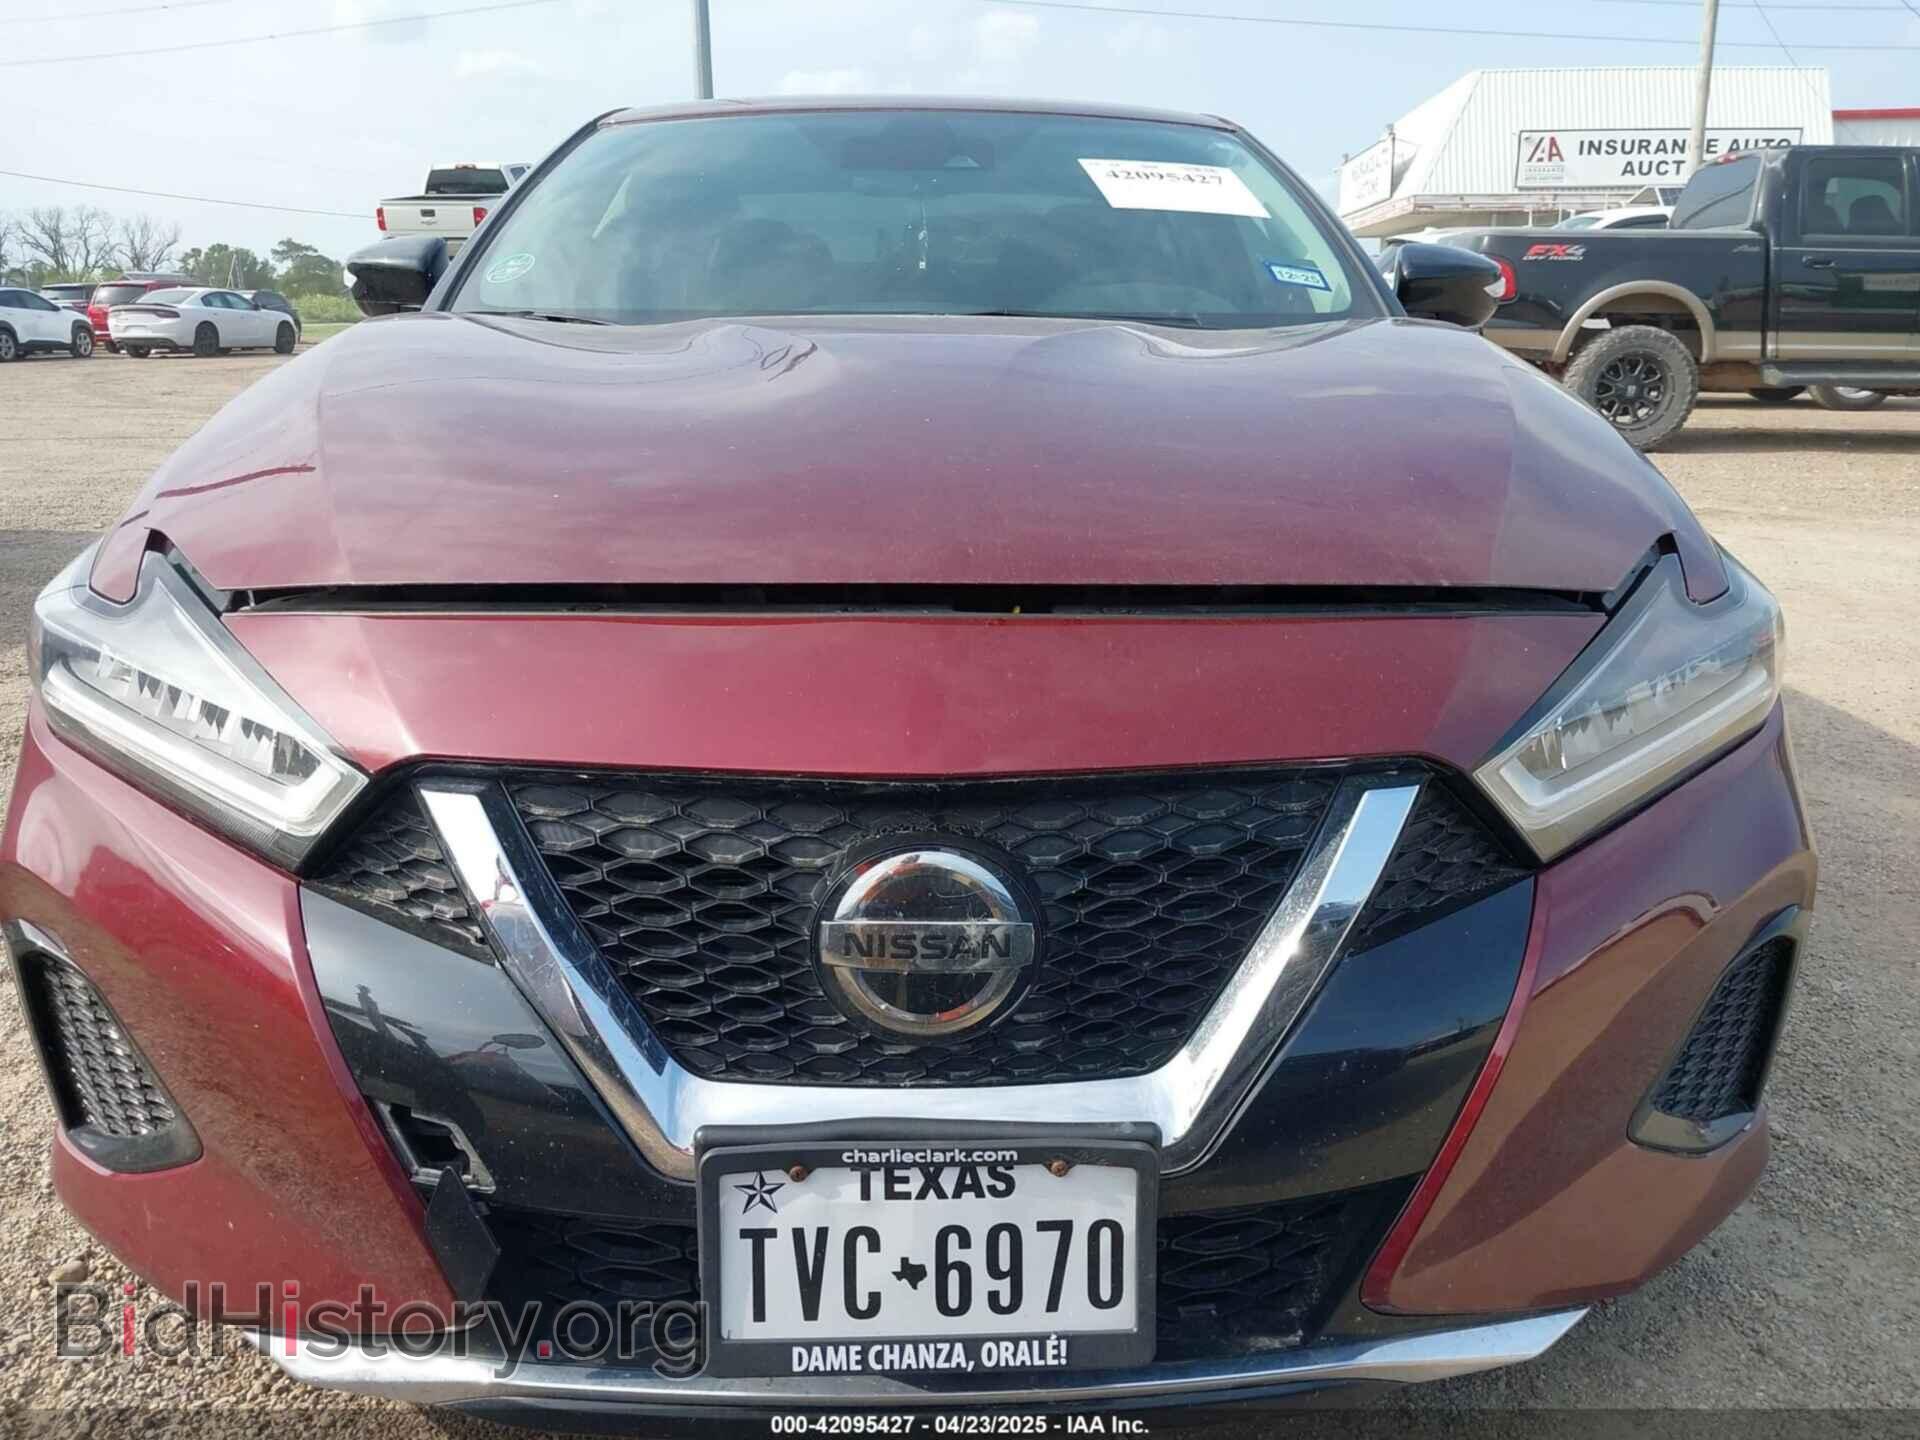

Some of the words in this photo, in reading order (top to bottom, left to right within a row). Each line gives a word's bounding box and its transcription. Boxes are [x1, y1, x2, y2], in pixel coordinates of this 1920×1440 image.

[1578, 138, 1718, 156] INSURANE
[1620, 160, 1686, 176] AUCT
[1527, 244, 1587, 256] FX4
[844, 932, 1011, 960] NISSAN
[841, 1149, 1018, 1163] charlieclark.com
[850, 1165, 1016, 1201] TEXAS
[739, 1225, 882, 1323] TVC
[934, 1218, 1125, 1317] 6970
[791, 1345, 863, 1373] DAME
[867, 1341, 975, 1372] CHANZA,
[981, 1334, 1067, 1368] ORALÉ!
